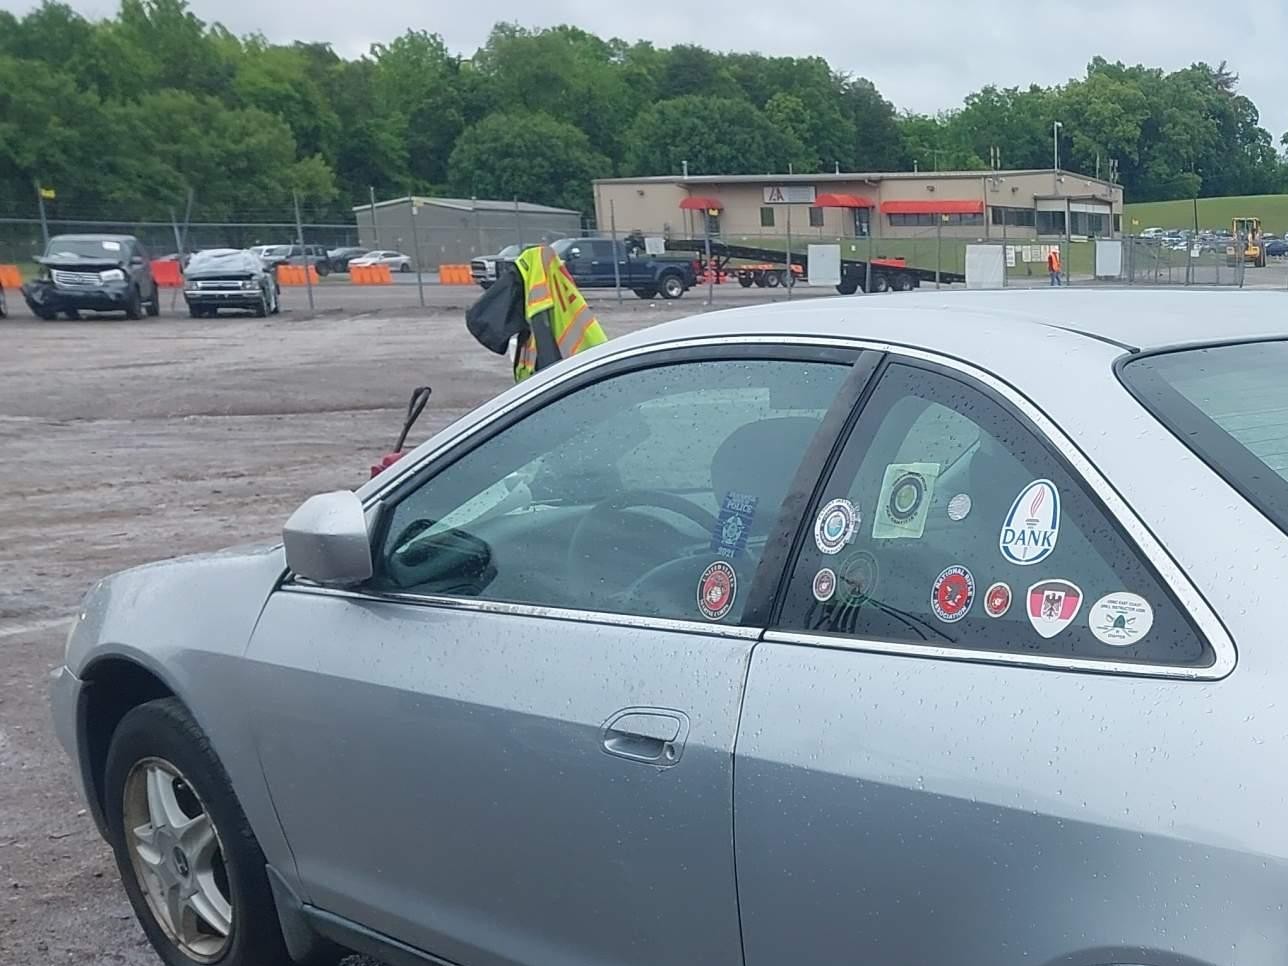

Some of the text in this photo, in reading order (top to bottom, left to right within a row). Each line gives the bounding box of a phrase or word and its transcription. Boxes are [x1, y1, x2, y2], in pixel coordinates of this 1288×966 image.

[1002, 528, 1056, 548] DANK
[935, 568, 973, 597] NATIONAL RIFLE
[934, 599, 967, 619] ASSOCIATION
